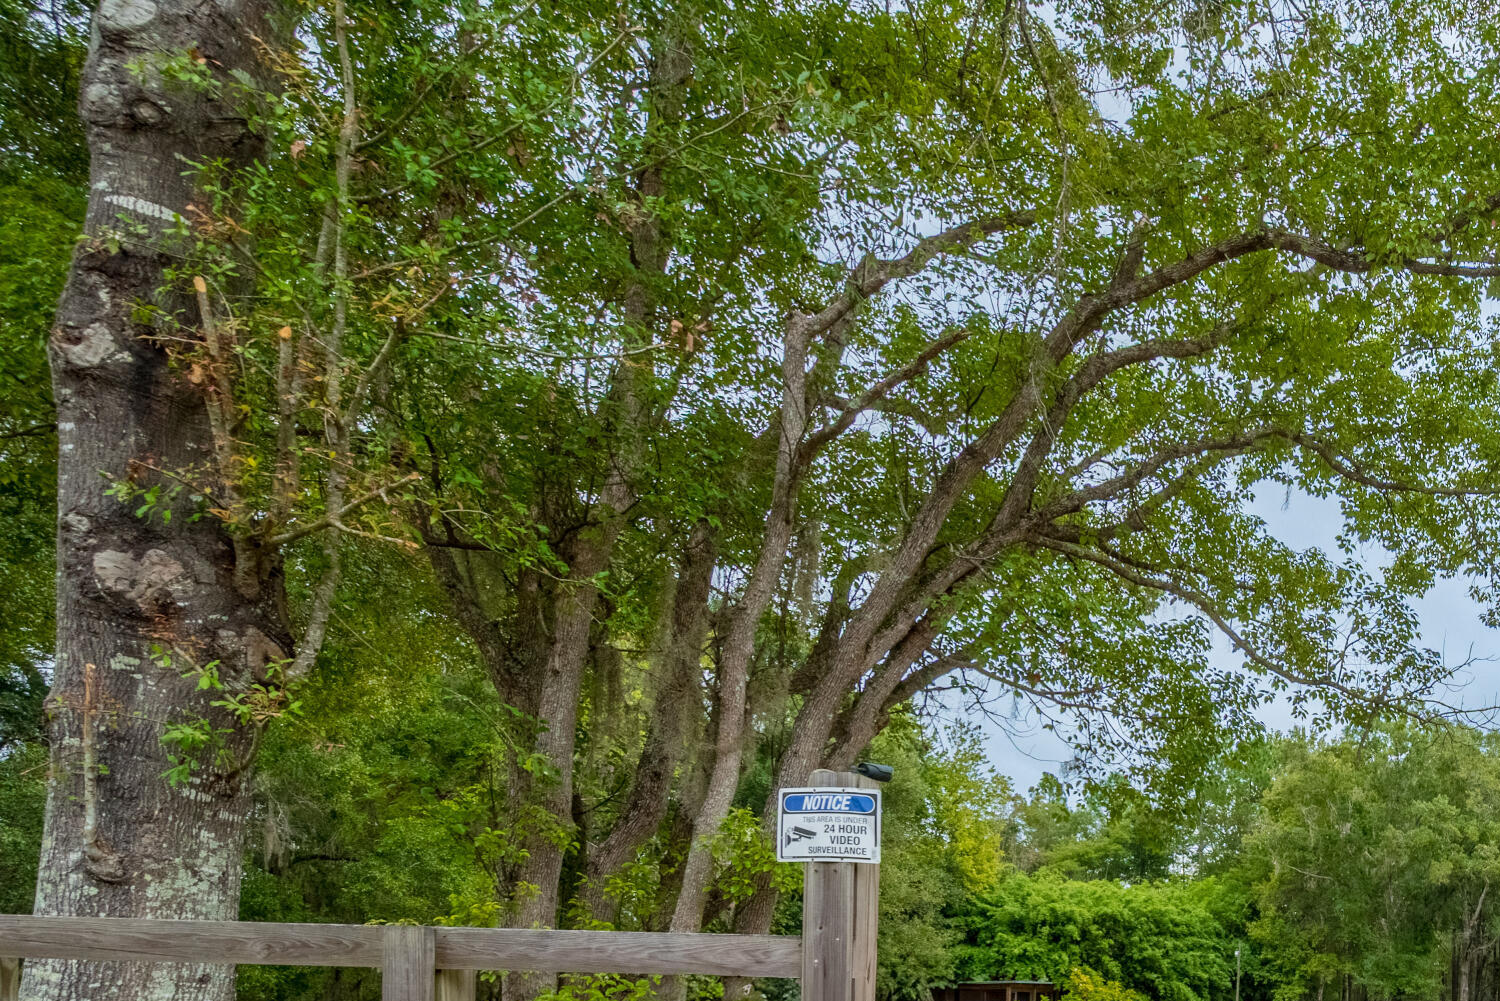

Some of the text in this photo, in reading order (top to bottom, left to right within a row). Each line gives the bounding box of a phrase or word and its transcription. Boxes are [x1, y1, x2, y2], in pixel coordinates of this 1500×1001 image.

[802, 795, 851, 810] NOTICE
[824, 825, 867, 834] 24 HOUR
[830, 836, 860, 845] VIDEO
[808, 847, 867, 855] SURVEILLANCE
